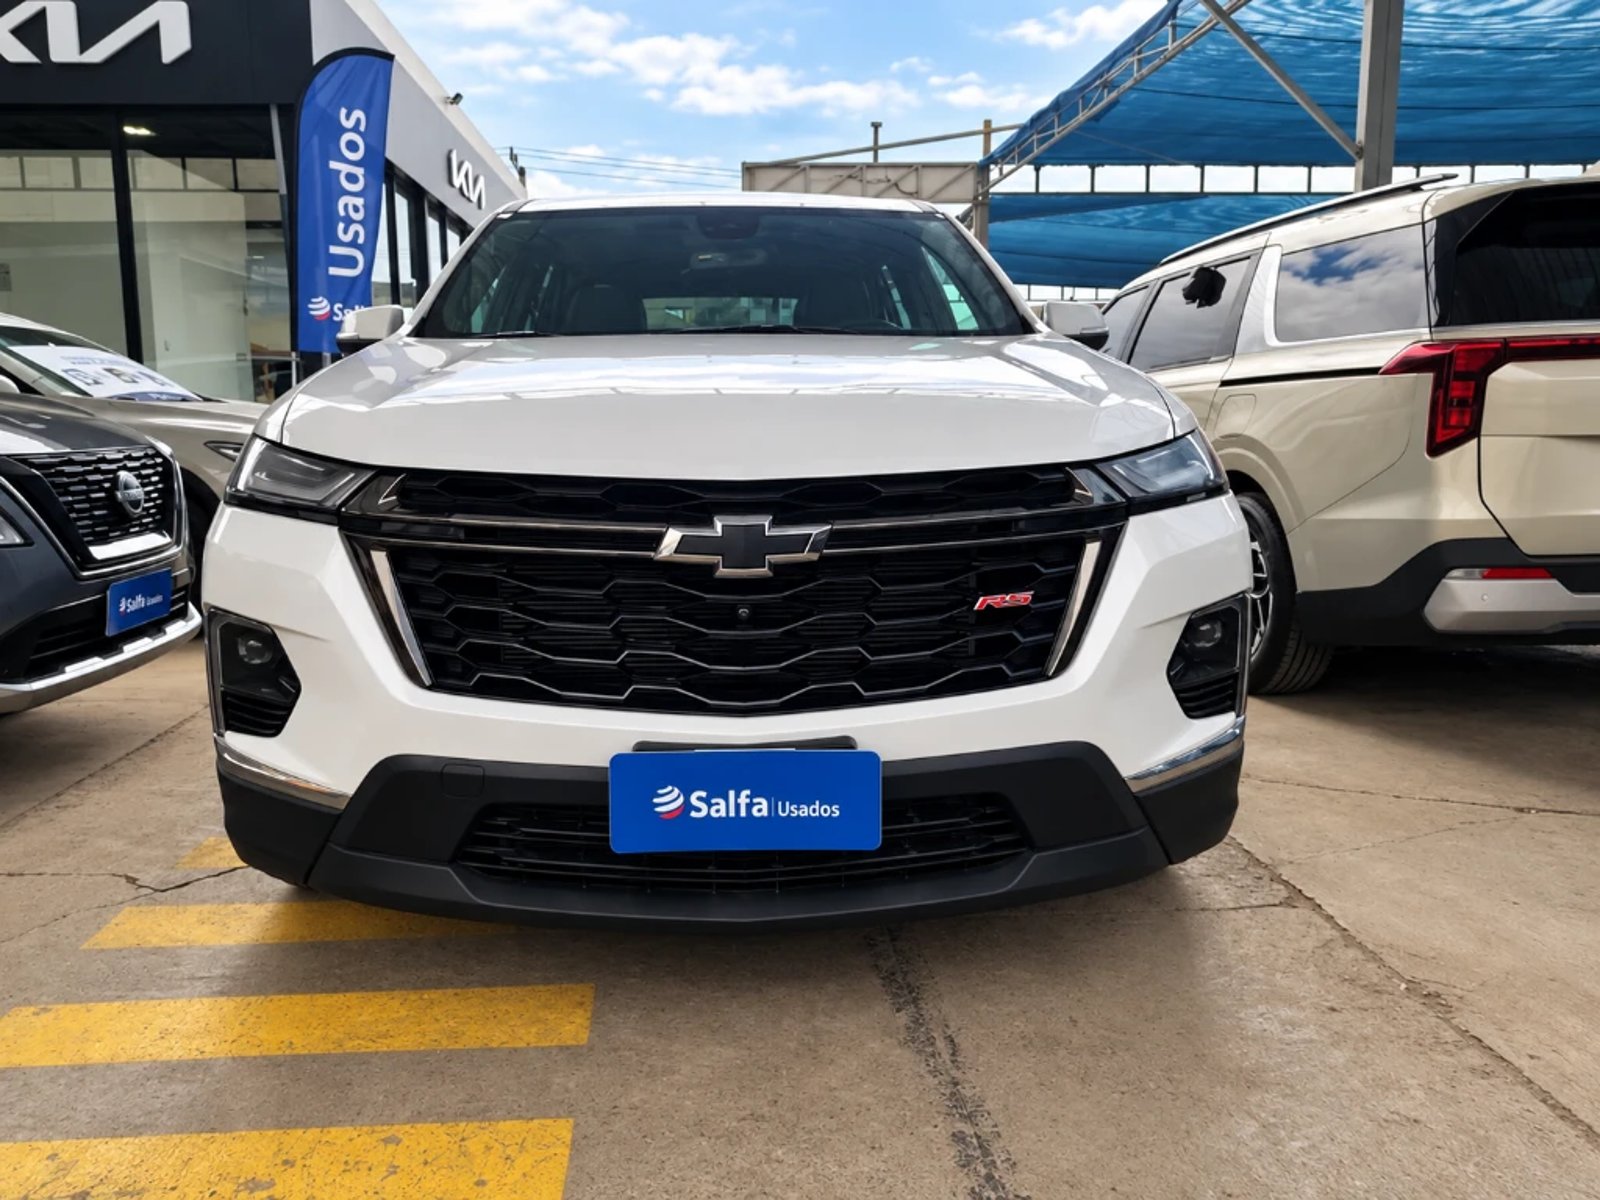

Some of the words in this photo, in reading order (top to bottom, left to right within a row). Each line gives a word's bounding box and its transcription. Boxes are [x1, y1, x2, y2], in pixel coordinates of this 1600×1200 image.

[328, 107, 367, 278] Usados
[974, 591, 1034, 610] RS
[690, 789, 769, 818] Salfa
[777, 800, 840, 817] Usados
